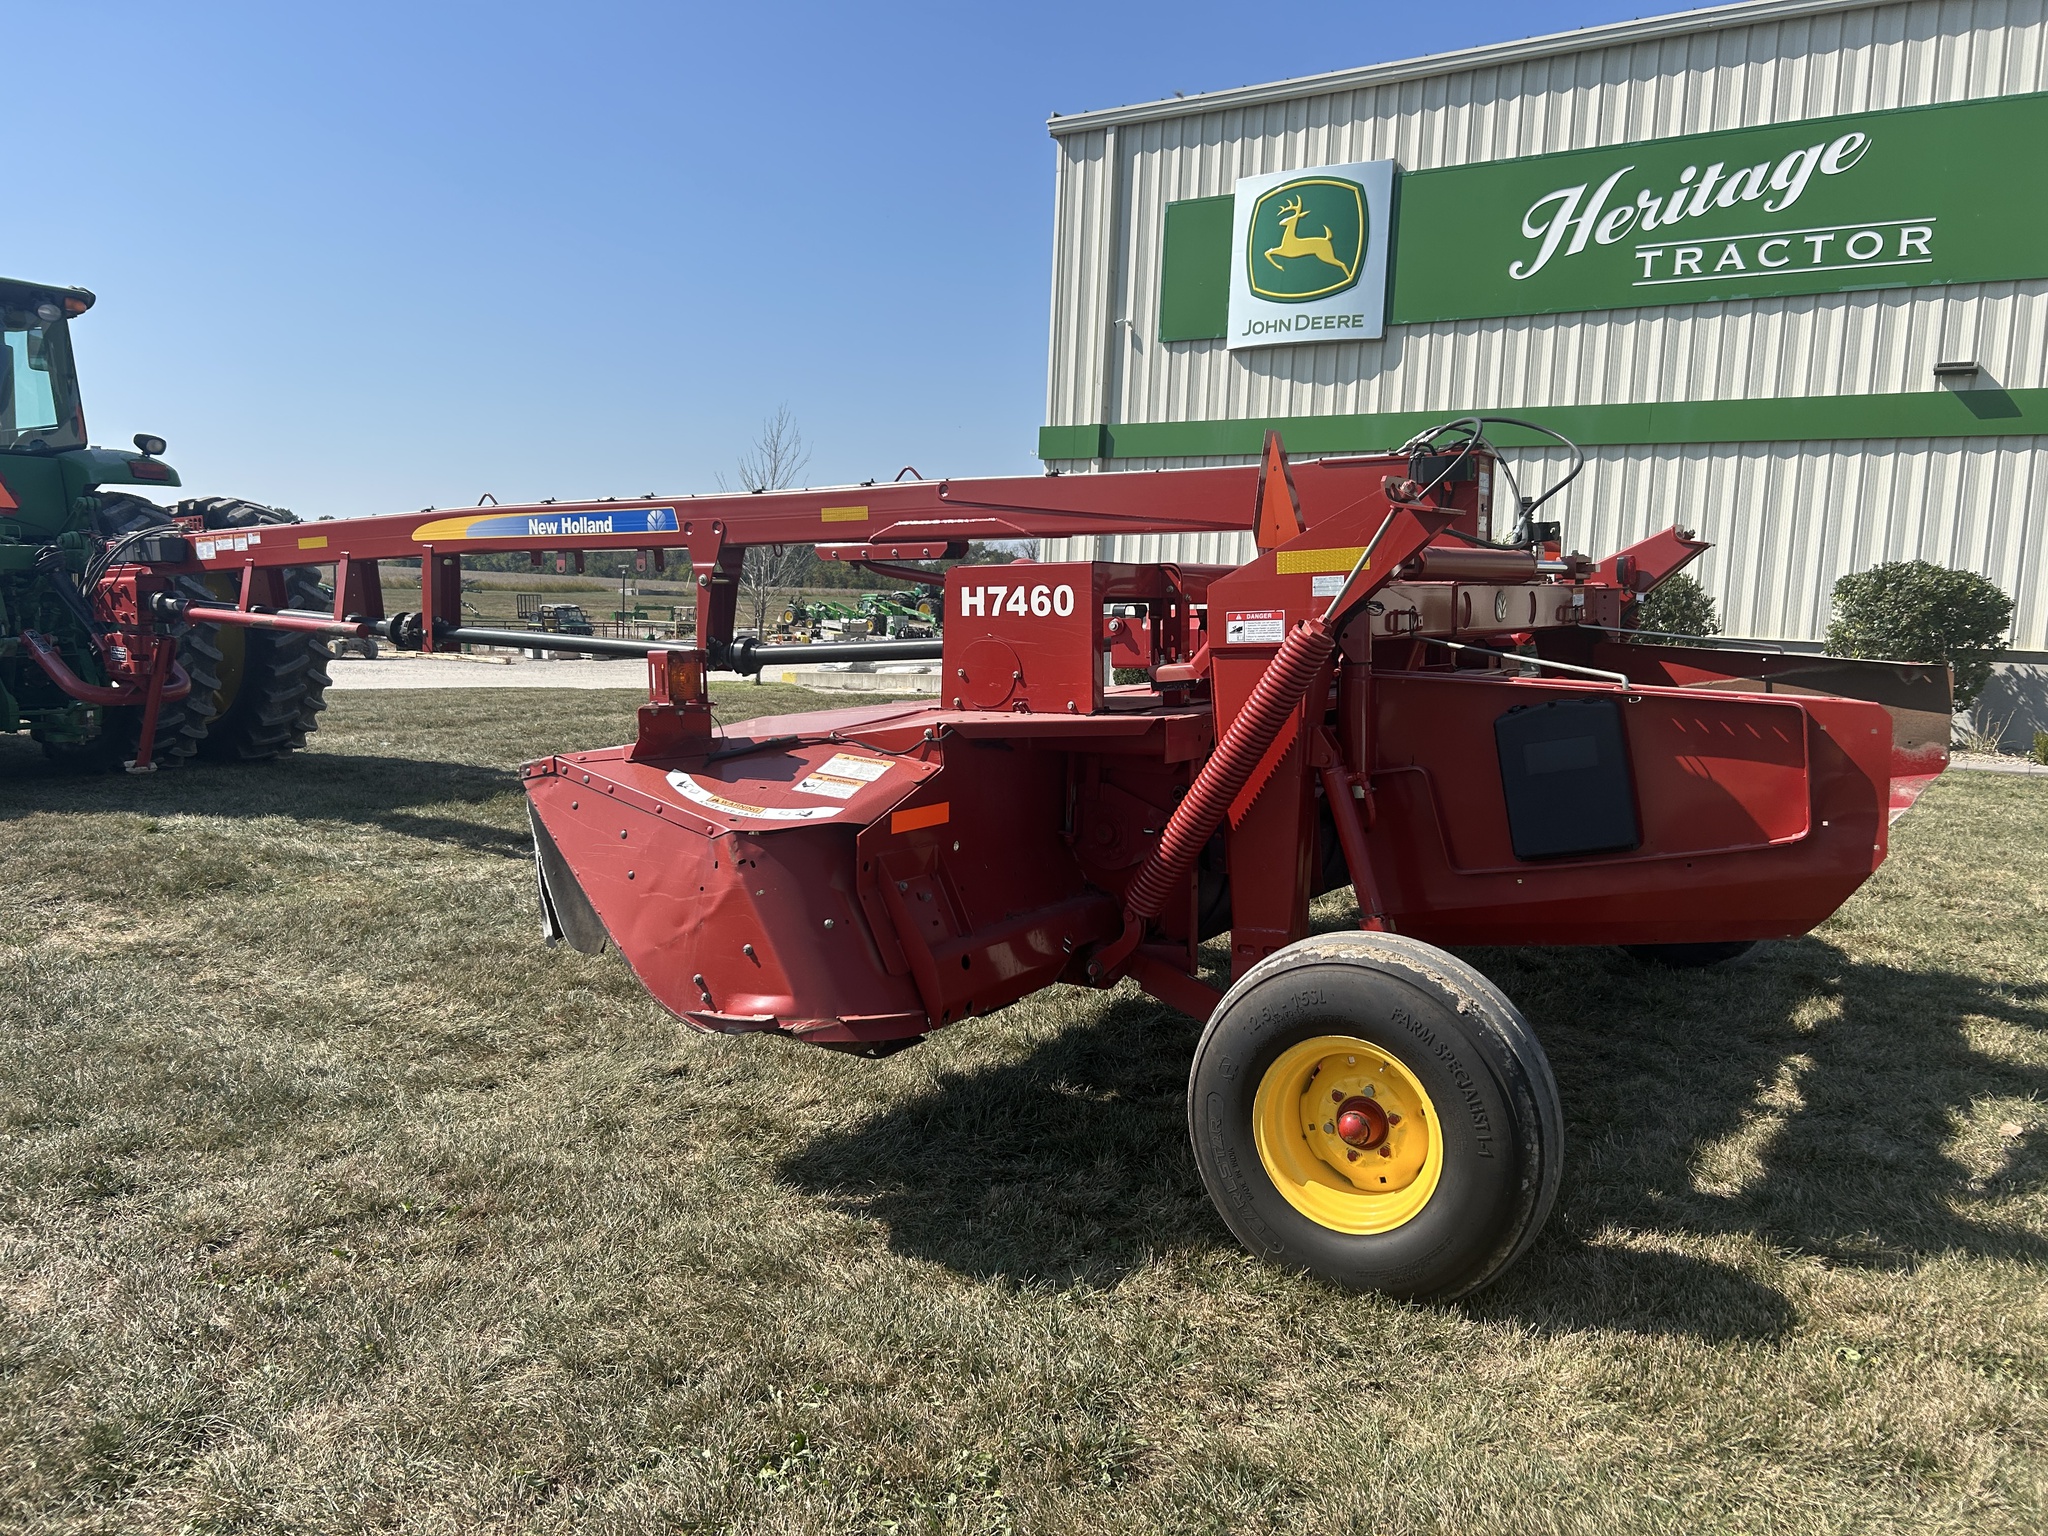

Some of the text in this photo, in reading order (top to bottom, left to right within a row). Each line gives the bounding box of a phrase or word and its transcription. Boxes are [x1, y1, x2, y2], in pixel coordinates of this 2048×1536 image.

[1508, 131, 1872, 280] Heritage
[1634, 225, 1933, 278] TRACTOR
[1241, 314, 1365, 336] JOHN DEERE
[527, 515, 613, 535] New Holland
[961, 584, 1075, 617] H7460
[721, 799, 761, 813] WARNING
[1391, 1007, 1436, 1047] FARM
[1434, 1041, 1491, 1132] SPECIALIST
[1210, 1116, 1266, 1236] CARLSTAR
